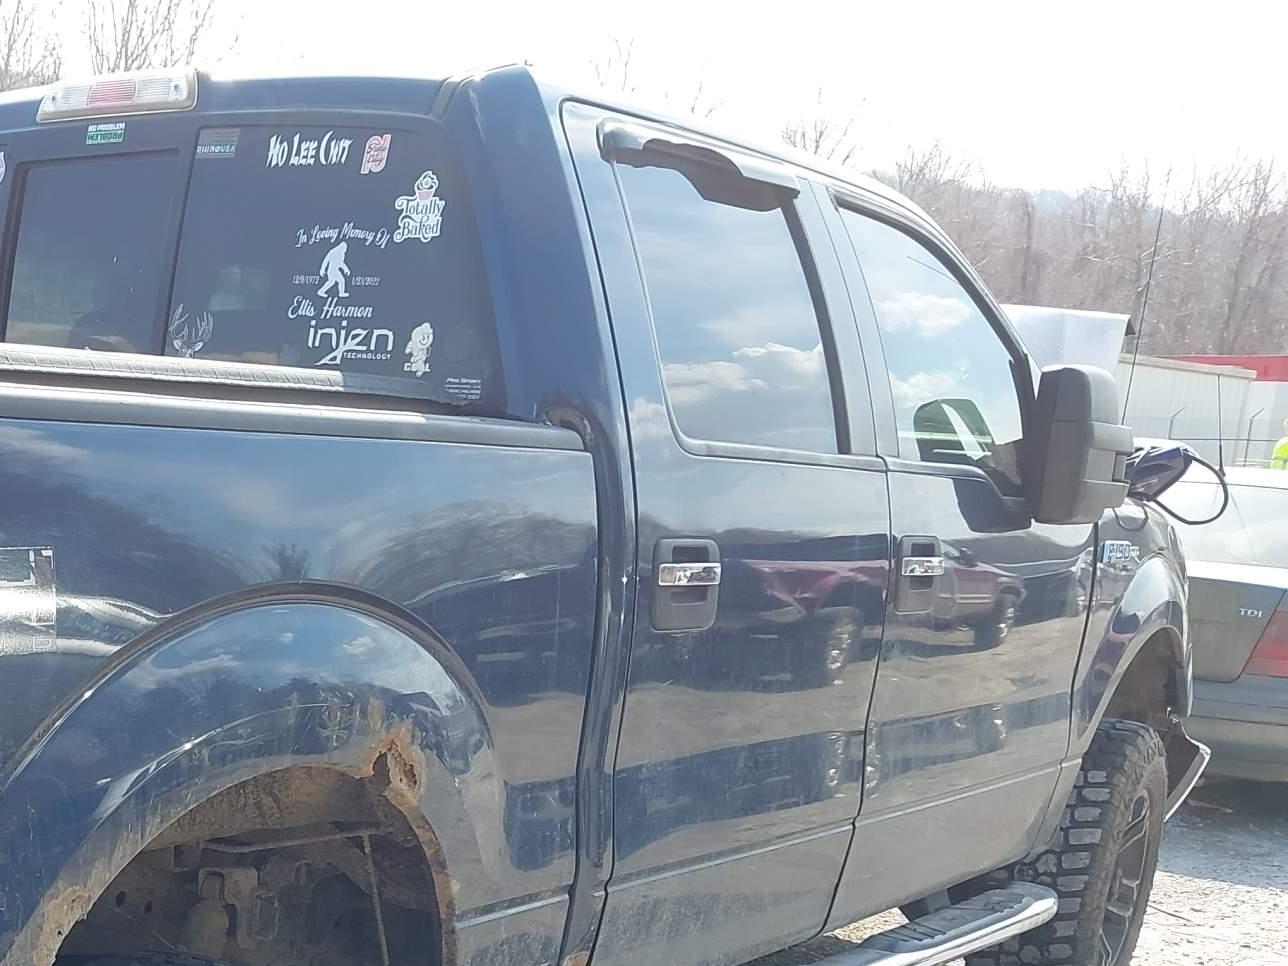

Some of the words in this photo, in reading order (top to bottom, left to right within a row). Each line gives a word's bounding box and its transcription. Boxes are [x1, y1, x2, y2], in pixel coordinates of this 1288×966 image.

[396, 198, 444, 217] Totally
[295, 229, 307, 247] In
[309, 225, 338, 245] Loving
[340, 222, 375, 245] Memory
[396, 217, 440, 241] Baked
[288, 296, 316, 318] Ellis
[320, 296, 373, 319] Harmon
[307, 320, 394, 365] injen
[343, 352, 391, 360] TECHNOLOGY
[1239, 608, 1263, 619] TDI
